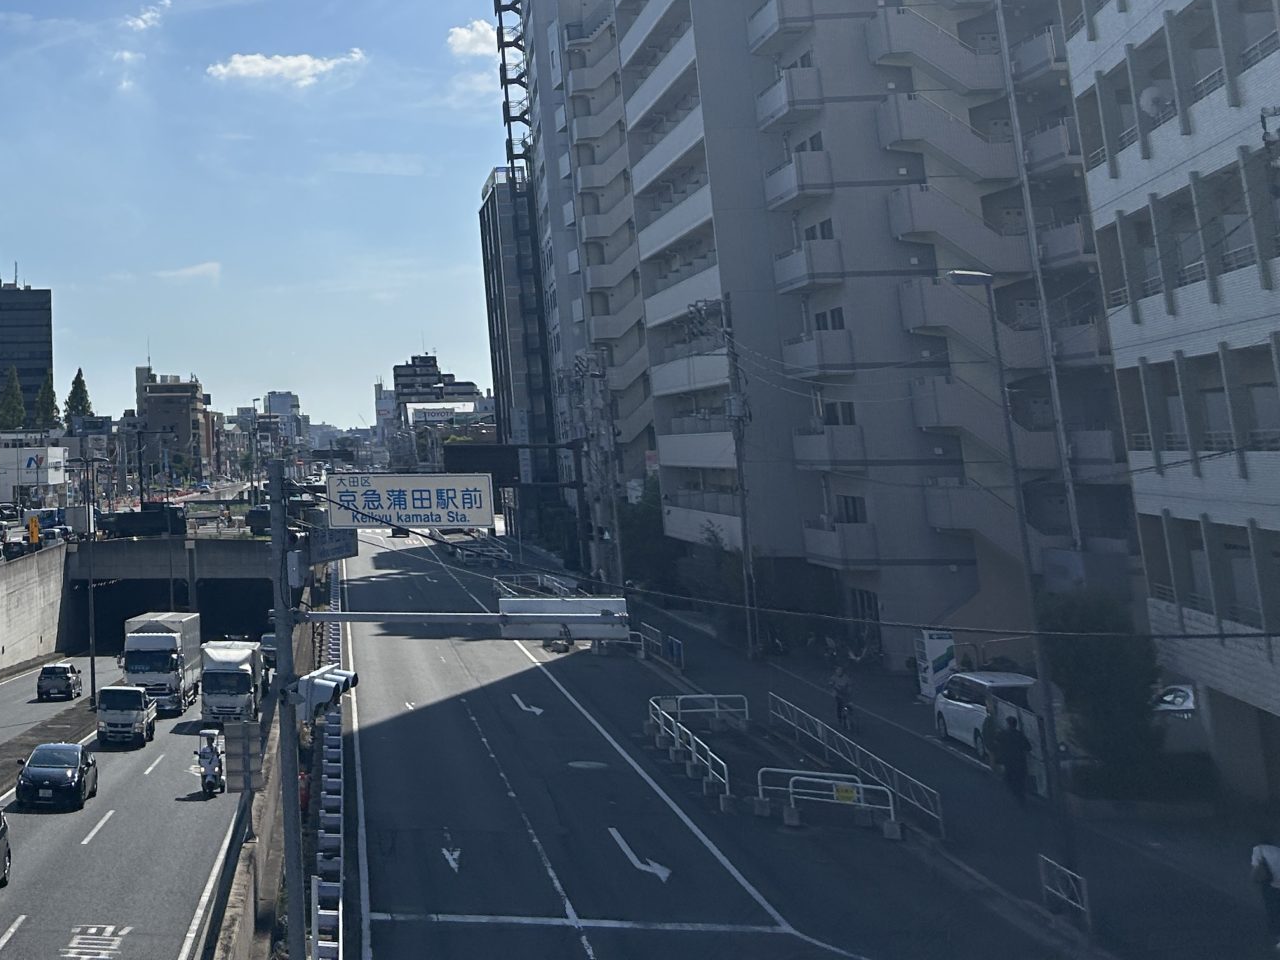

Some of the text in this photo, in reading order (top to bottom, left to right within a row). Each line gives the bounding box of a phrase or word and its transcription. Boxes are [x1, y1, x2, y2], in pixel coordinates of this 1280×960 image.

[336, 478, 371, 487] 大田区
[336, 488, 483, 510] 京急蒲田駅前
[351, 511, 470, 525] Keikyu kamata Sta.
